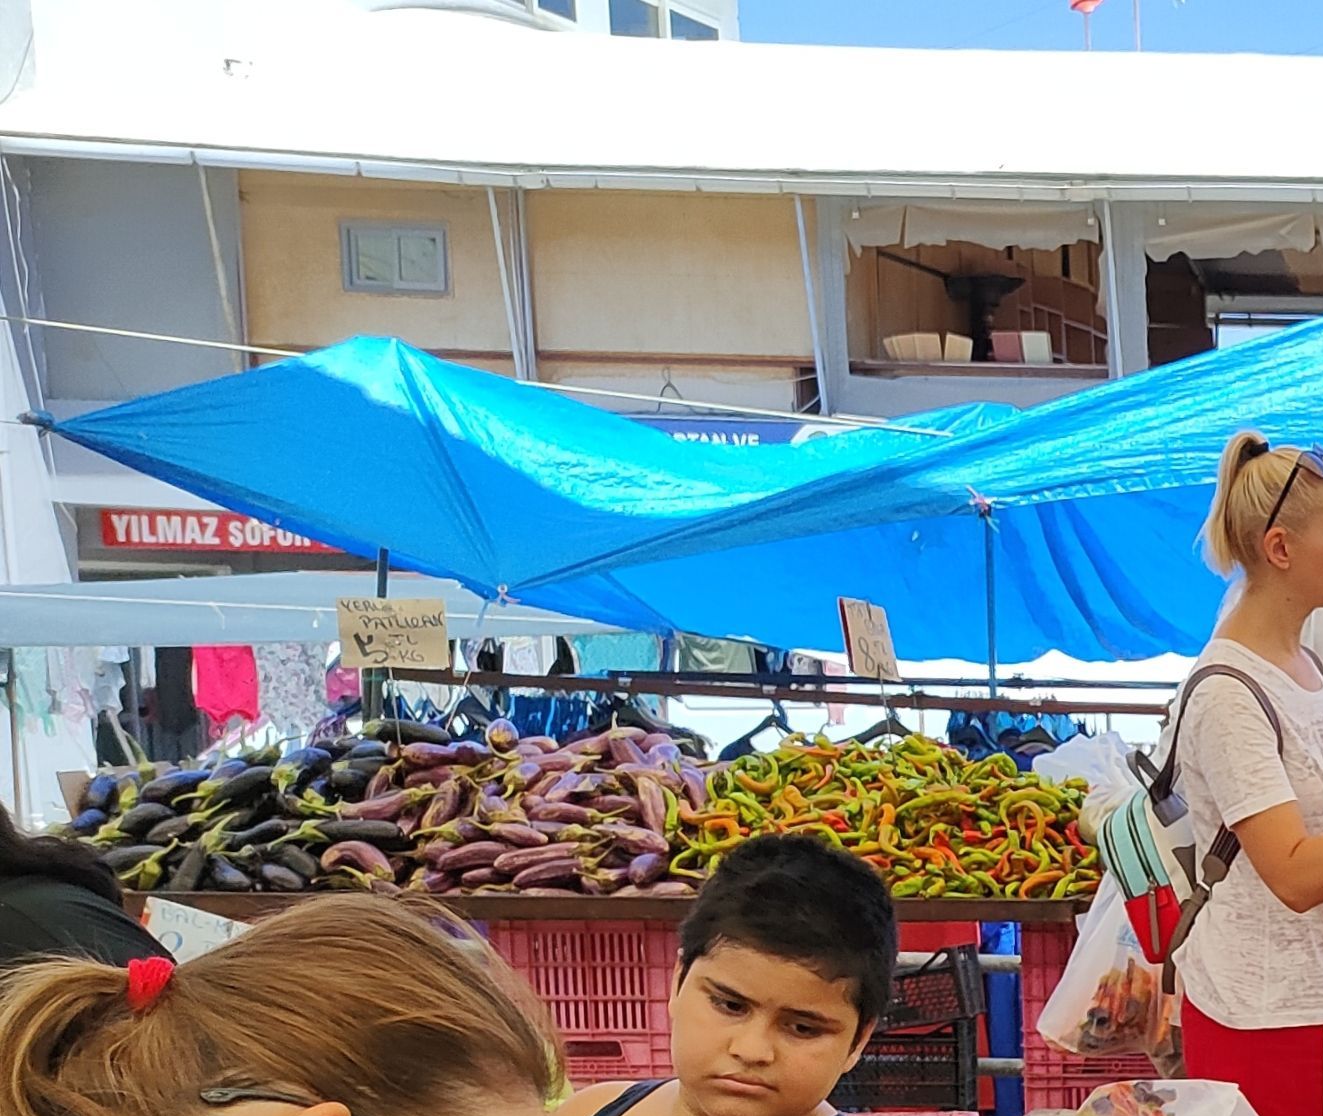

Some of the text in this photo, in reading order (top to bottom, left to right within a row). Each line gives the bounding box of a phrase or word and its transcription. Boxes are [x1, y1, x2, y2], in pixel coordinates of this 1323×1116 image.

[110, 513, 221, 545] YILMAZ
[353, 632, 389, 663] 5
[858, 636, 875, 673] 8
